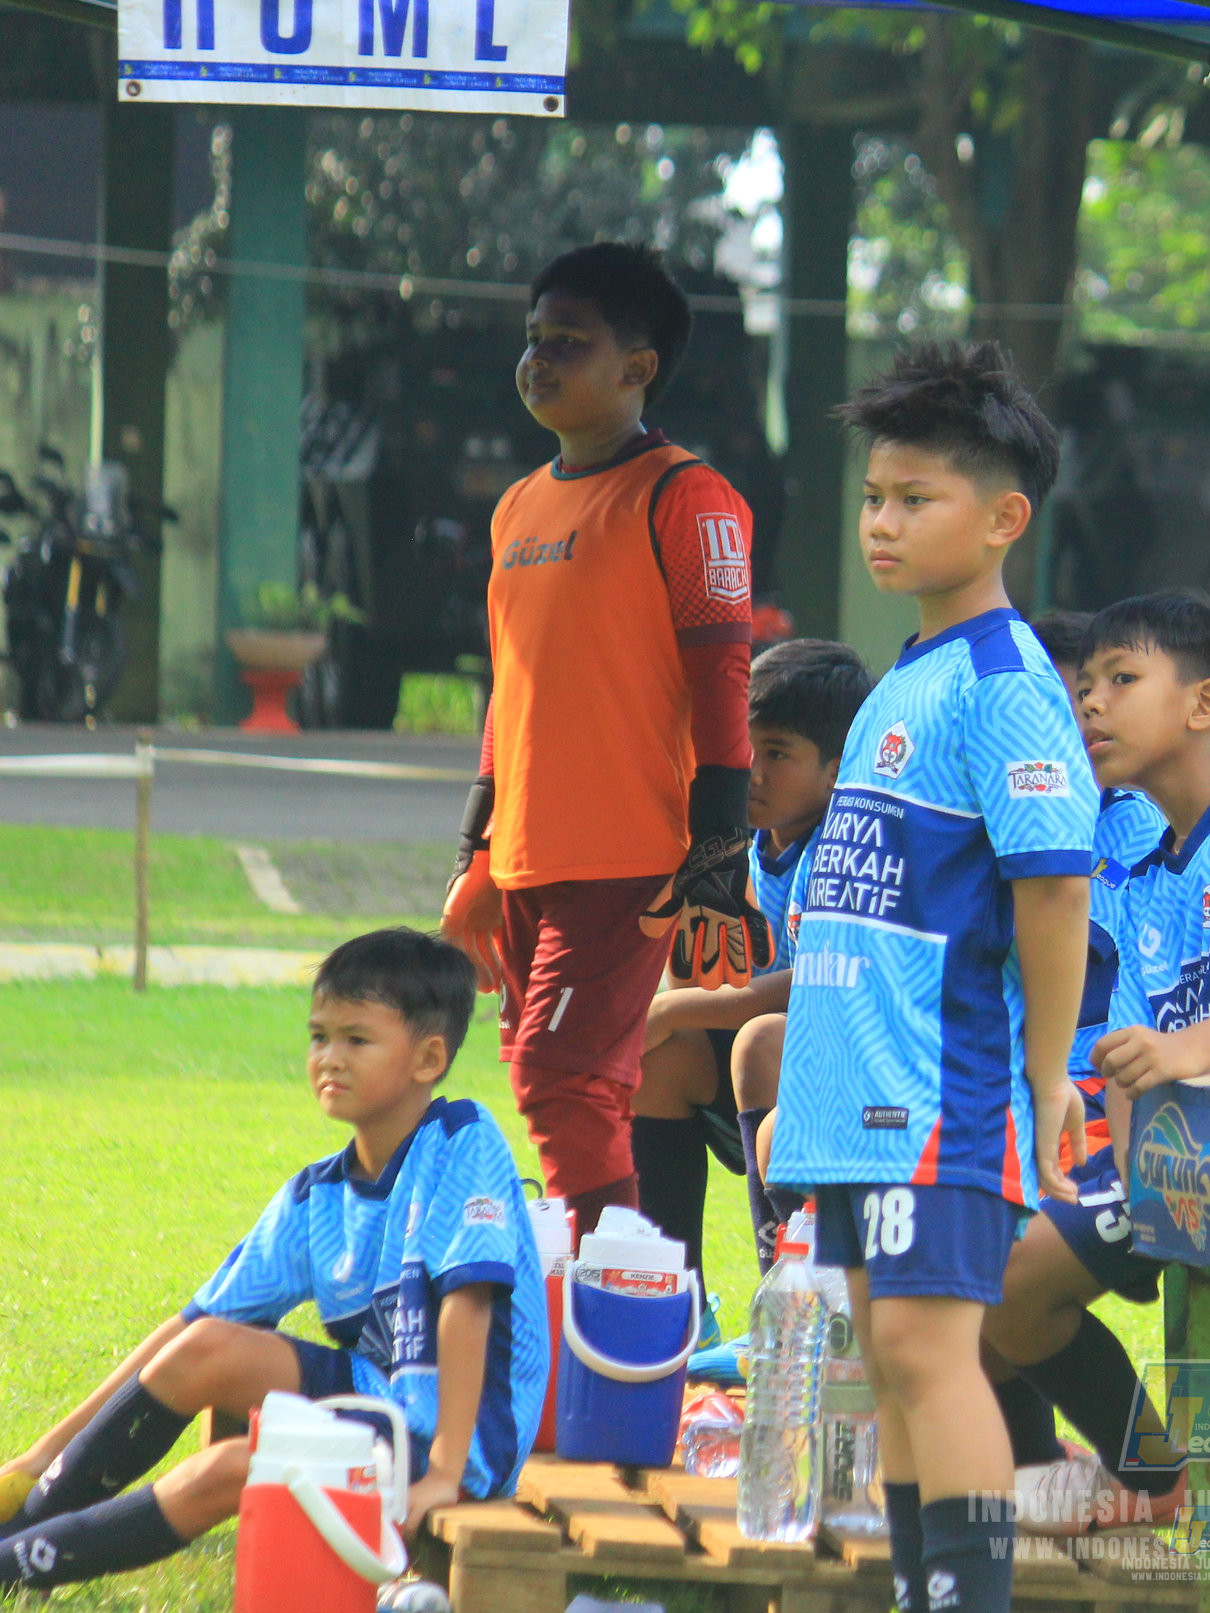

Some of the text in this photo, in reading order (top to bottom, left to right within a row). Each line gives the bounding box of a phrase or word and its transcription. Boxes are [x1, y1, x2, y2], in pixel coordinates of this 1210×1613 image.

[502, 530, 577, 569] Güzel
[854, 797, 904, 819] KONSUMEN
[812, 845, 904, 886] BERKAH
[863, 1187, 914, 1260] 28
